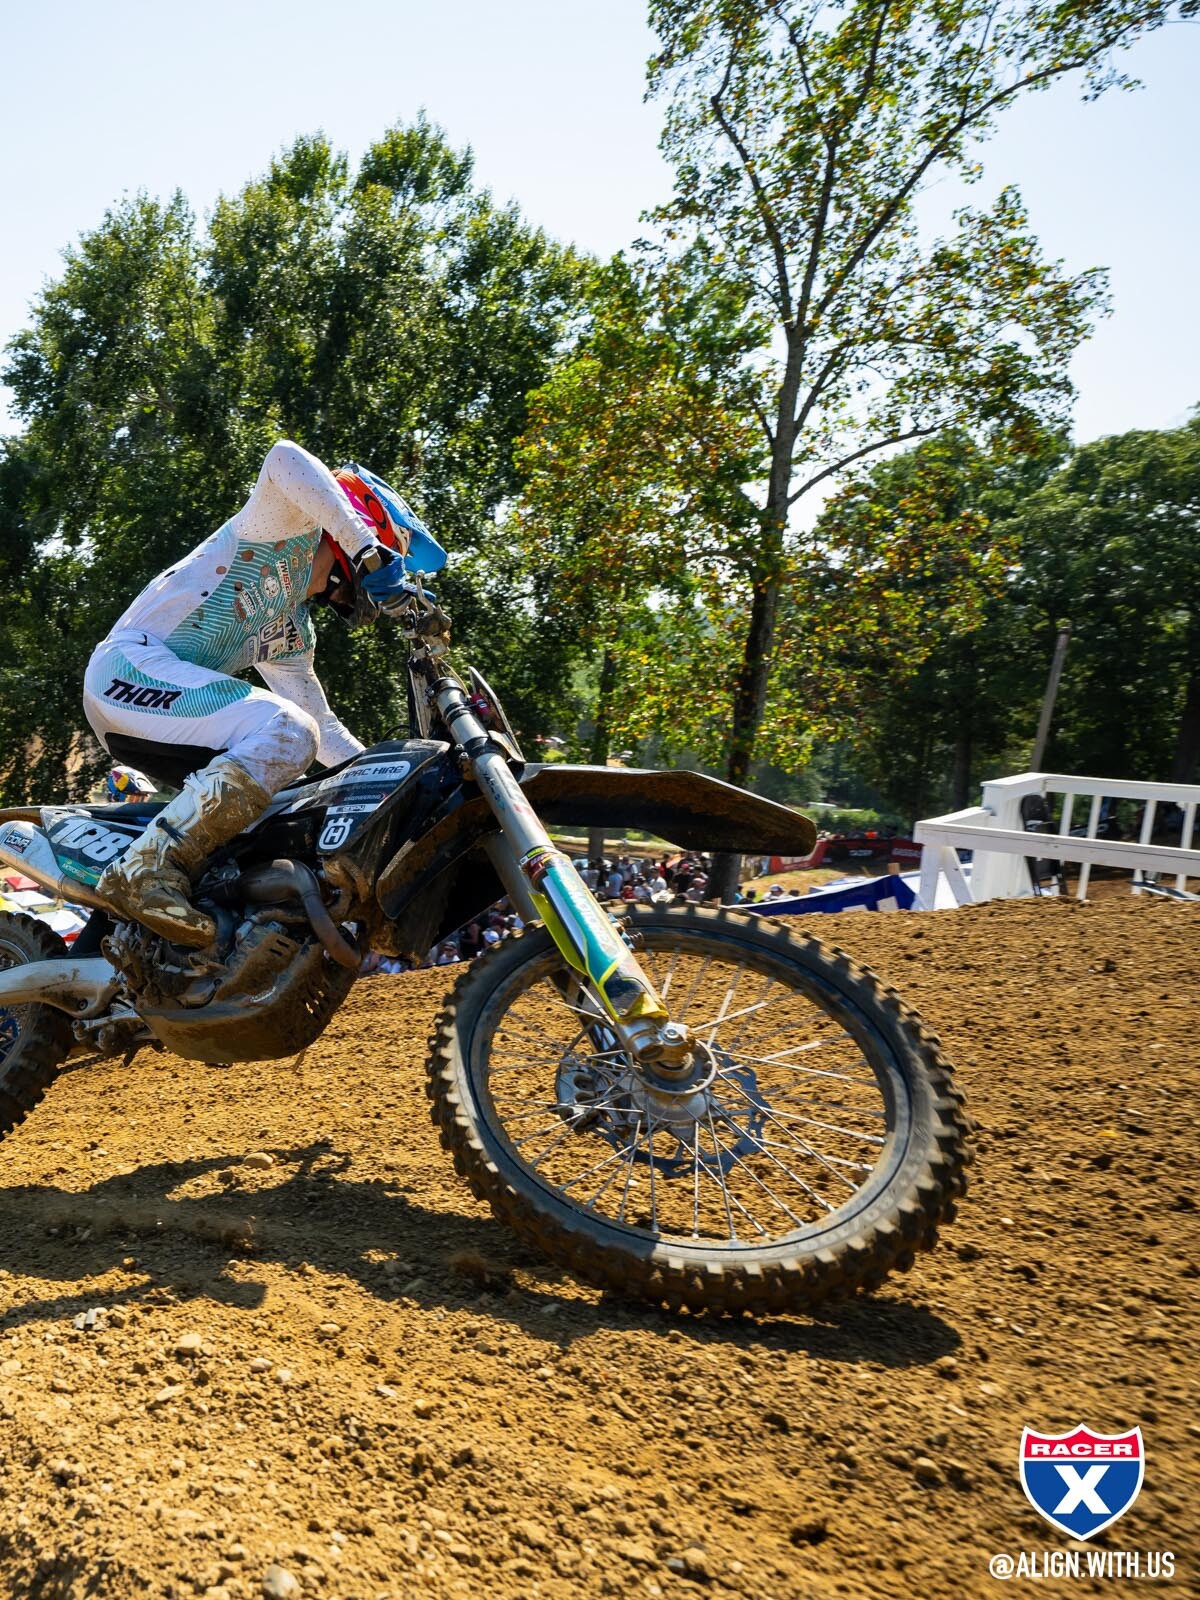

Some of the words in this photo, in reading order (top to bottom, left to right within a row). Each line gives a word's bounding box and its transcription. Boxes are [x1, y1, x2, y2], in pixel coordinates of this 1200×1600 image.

[103, 679, 183, 710] THOR
[372, 765, 405, 776] HIRE
[50, 818, 135, 862] 108
